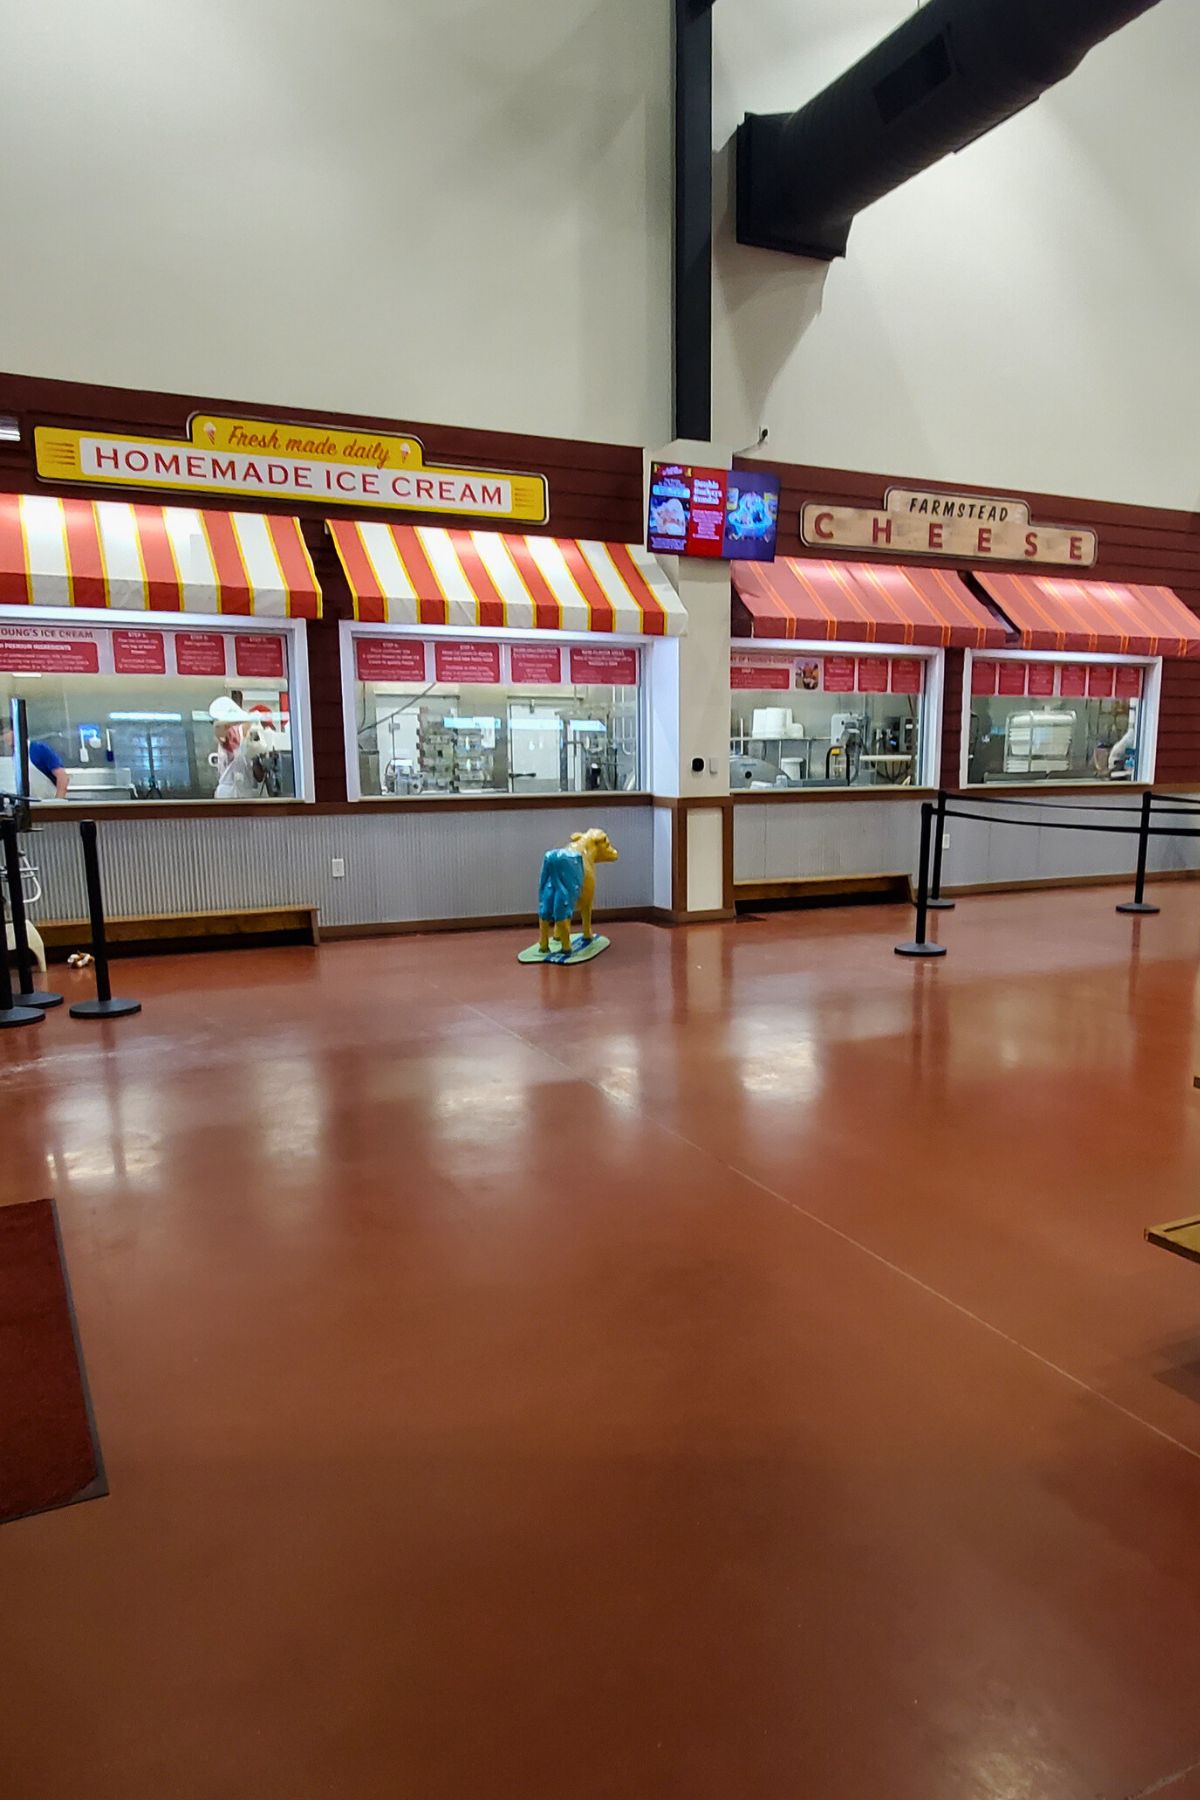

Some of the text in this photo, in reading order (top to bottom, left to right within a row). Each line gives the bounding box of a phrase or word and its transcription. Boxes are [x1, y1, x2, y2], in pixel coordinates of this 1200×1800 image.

[227, 425, 390, 469] Fresh made daily
[95, 446, 503, 506] HOMEMADE ICE CREAM
[908, 497, 1009, 523] FARMSTEAD
[814, 512, 1083, 561] CHEESE
[41, 628, 55, 637] ICE
[58, 629, 94, 638] CREAM
